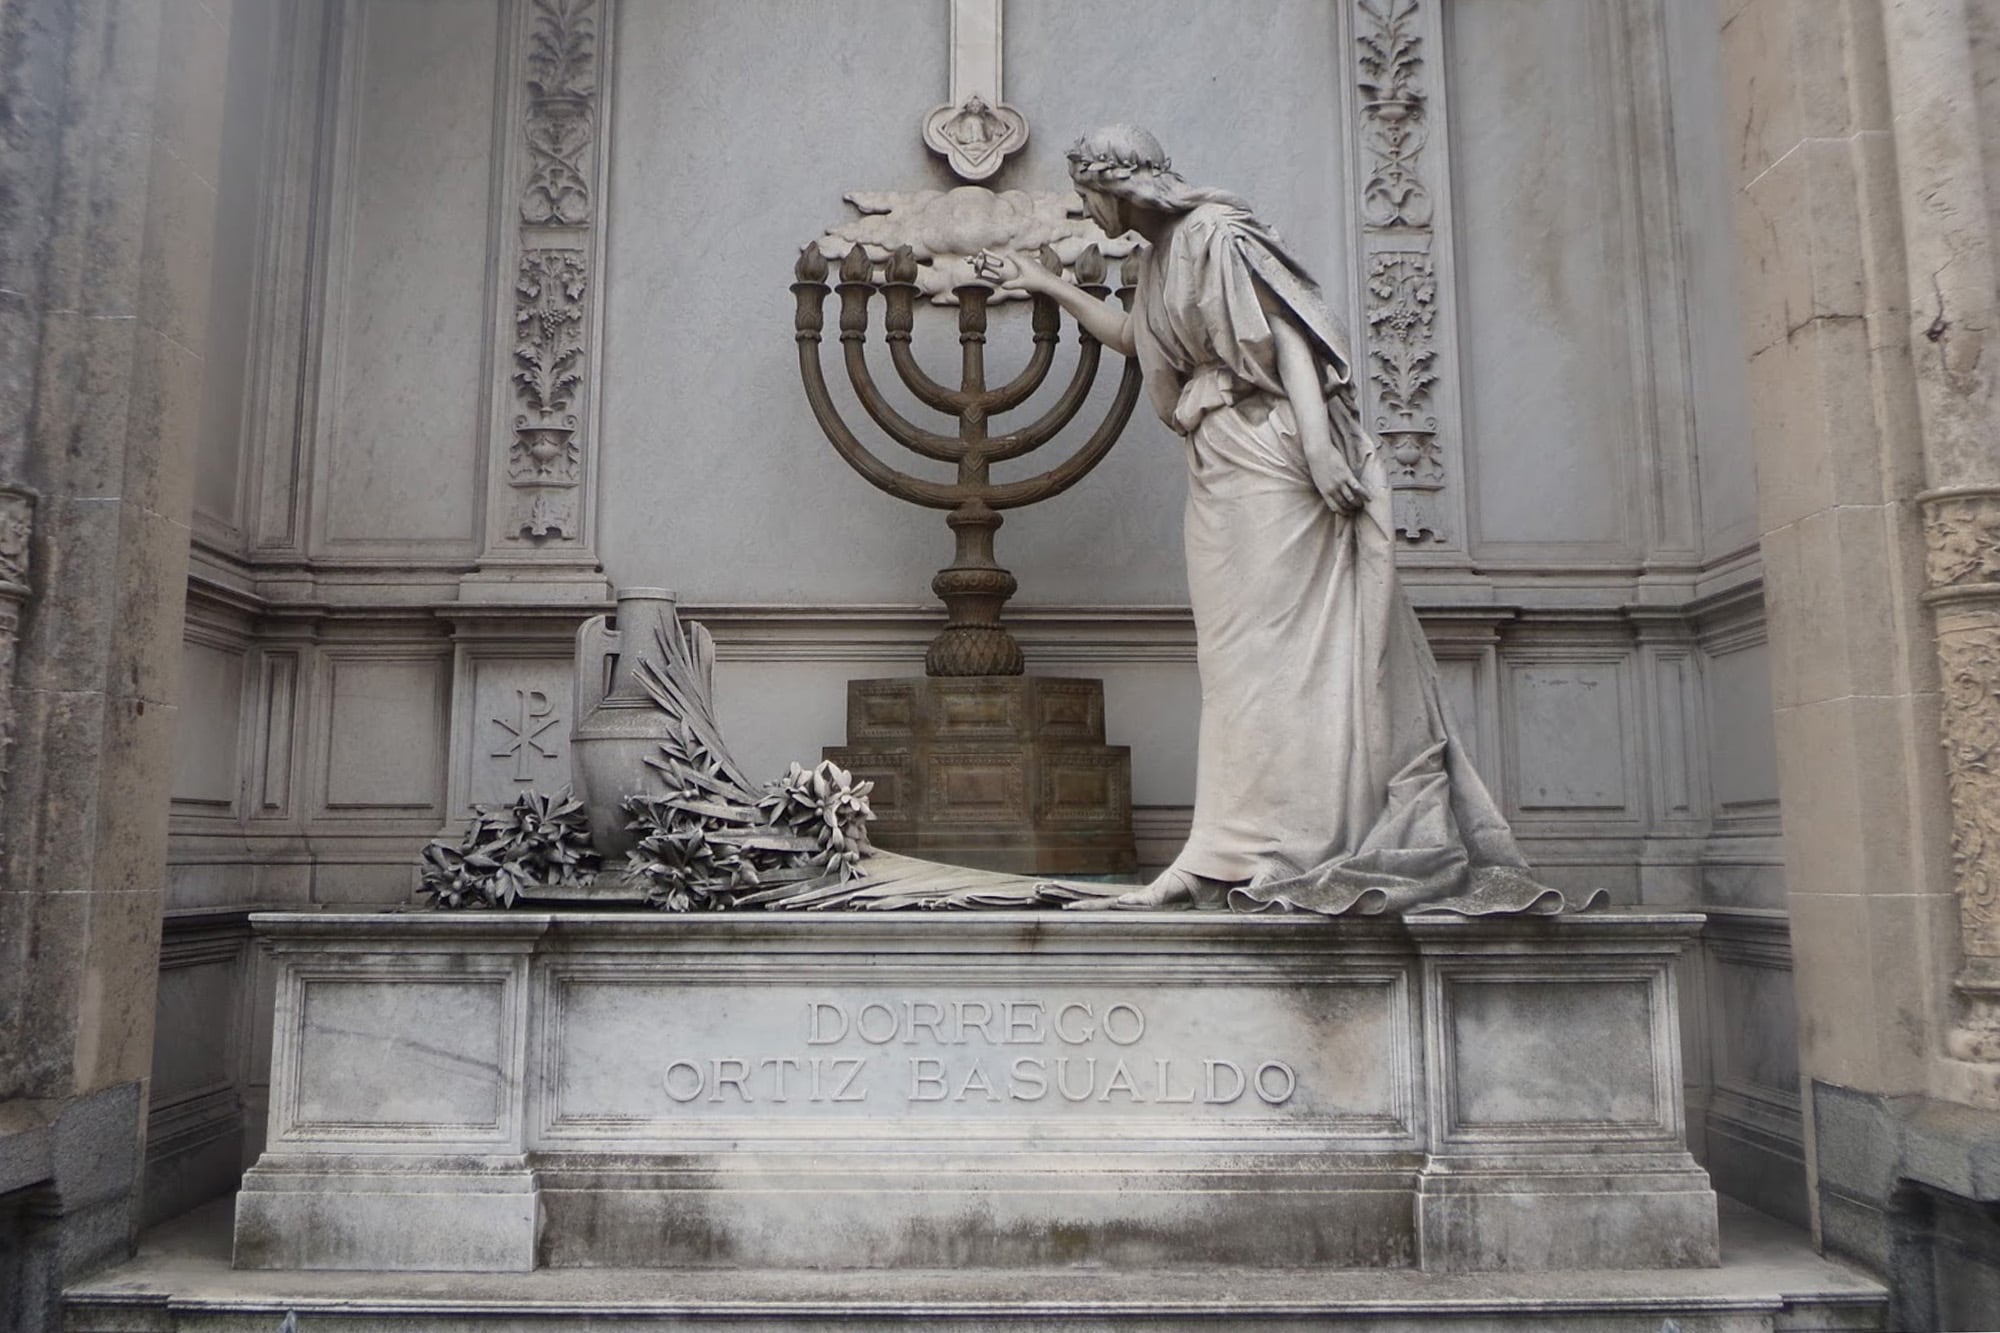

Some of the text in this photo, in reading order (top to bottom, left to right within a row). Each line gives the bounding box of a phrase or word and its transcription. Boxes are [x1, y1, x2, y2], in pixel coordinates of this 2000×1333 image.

[806, 1002, 1146, 1045] DORREGO
[664, 1059, 1297, 1104] ORTIZ BASUALDO
